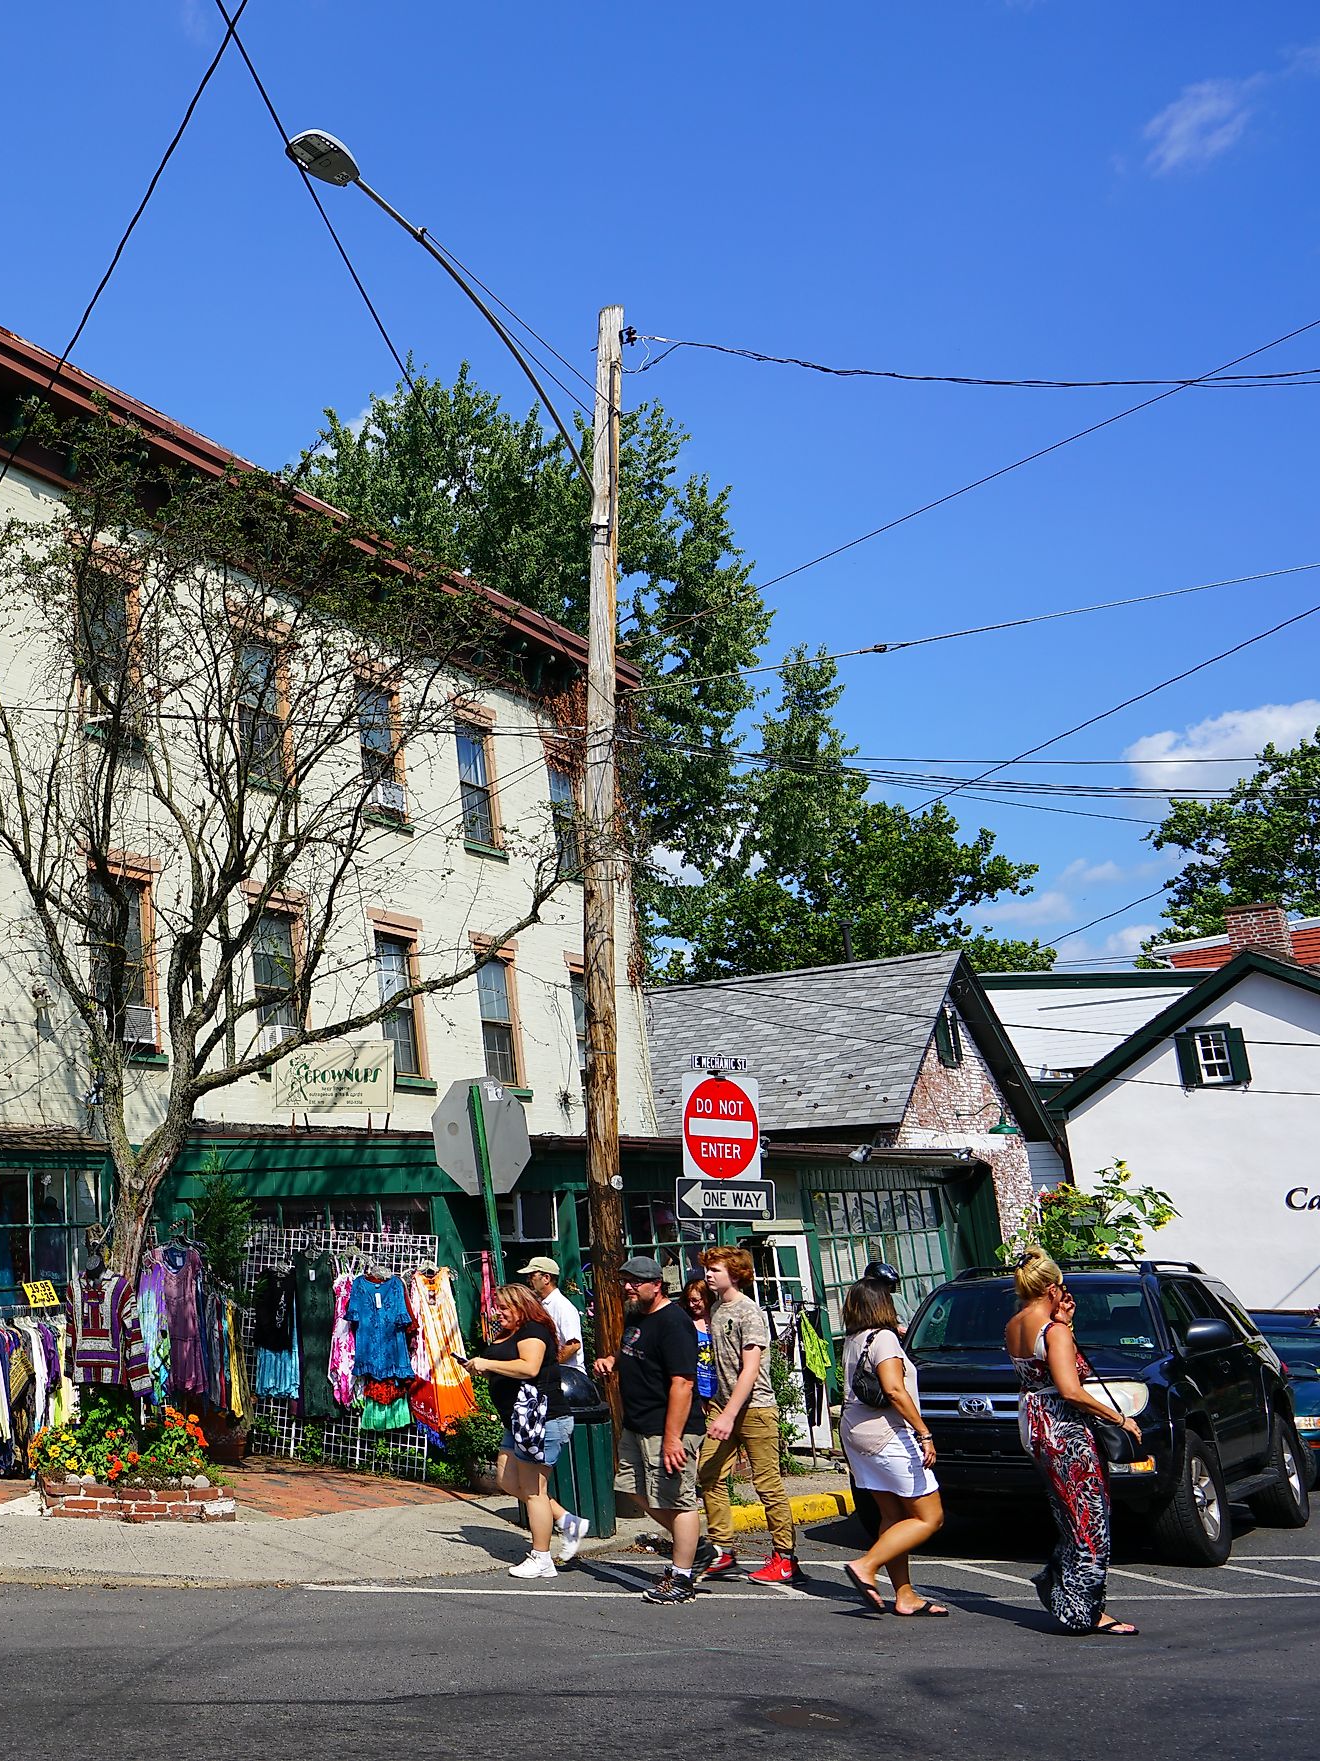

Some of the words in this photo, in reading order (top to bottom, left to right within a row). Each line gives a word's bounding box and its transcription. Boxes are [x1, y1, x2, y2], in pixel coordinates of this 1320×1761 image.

[694, 1056, 700, 1068] E
[701, 1057, 735, 1070] MECHANIC
[304, 1067, 383, 1085] GROWNUPS
[696, 1097, 713, 1114] DO
[719, 1099, 744, 1116] NOT
[700, 1142, 742, 1160] ENTER
[703, 1191, 728, 1207] ONE
[732, 1191, 762, 1208] WAY
[31, 1294, 39, 1304] 2
